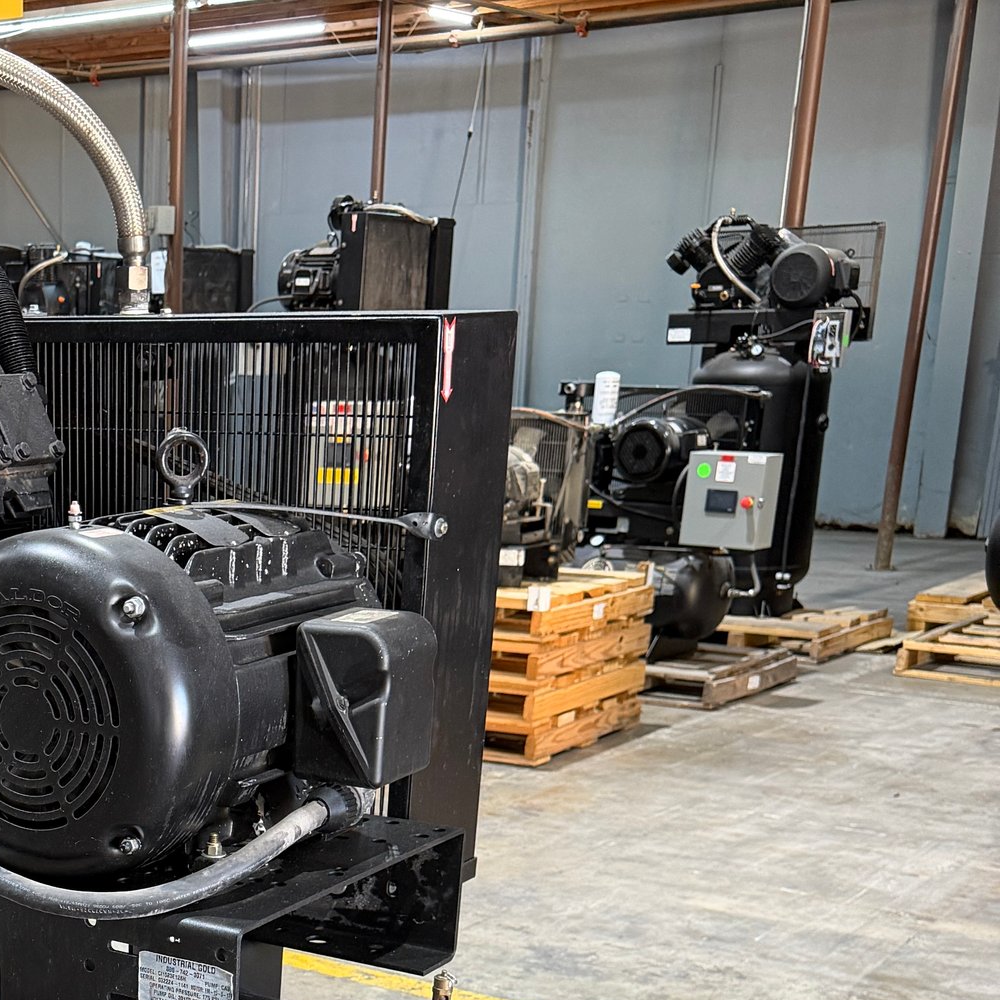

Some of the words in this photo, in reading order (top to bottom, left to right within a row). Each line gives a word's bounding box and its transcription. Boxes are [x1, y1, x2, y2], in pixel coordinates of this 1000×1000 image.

[156, 955, 195, 970] INDUSTRIAL
[198, 964, 216, 974] GOLD
[149, 982, 175, 993] OPERATING
[175, 986, 201, 998] PRESSURE:
[154, 989, 167, 998] PUMP
